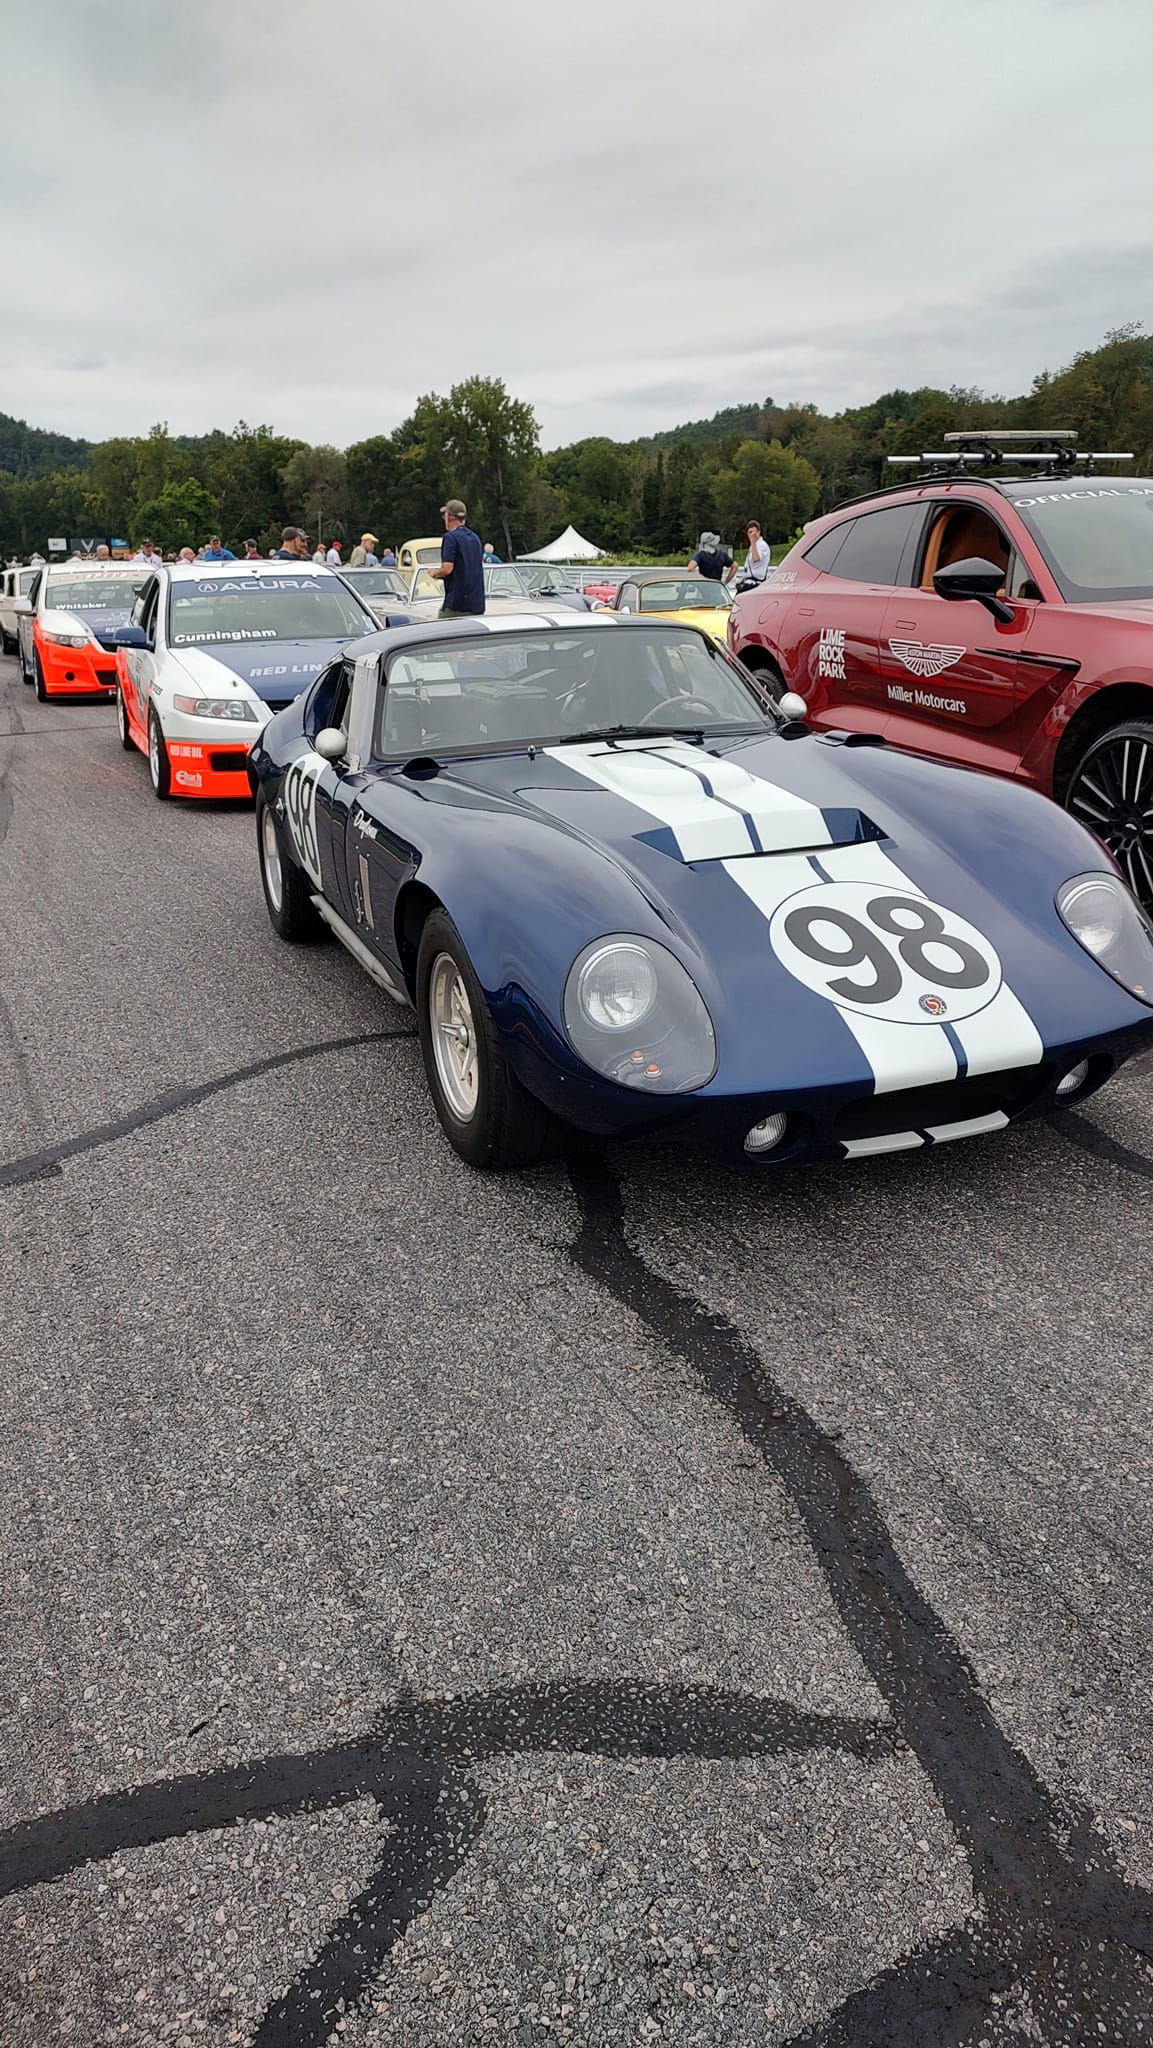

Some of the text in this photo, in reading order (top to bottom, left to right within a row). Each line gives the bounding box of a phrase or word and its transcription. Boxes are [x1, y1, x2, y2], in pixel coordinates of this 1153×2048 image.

[1014, 489, 1127, 508] OFFICIAL
[220, 580, 322, 592] ACURA
[56, 602, 107, 610] Whitaker
[174, 629, 277, 643] Cunningham
[820, 628, 846, 646] LIME
[819, 645, 845, 663] ROCK
[250, 664, 325, 677] RED LIN
[819, 661, 846, 680] PARK
[887, 684, 967, 714] Miller Motorcars
[288, 760, 320, 876] 98
[784, 895, 990, 1004] 98
